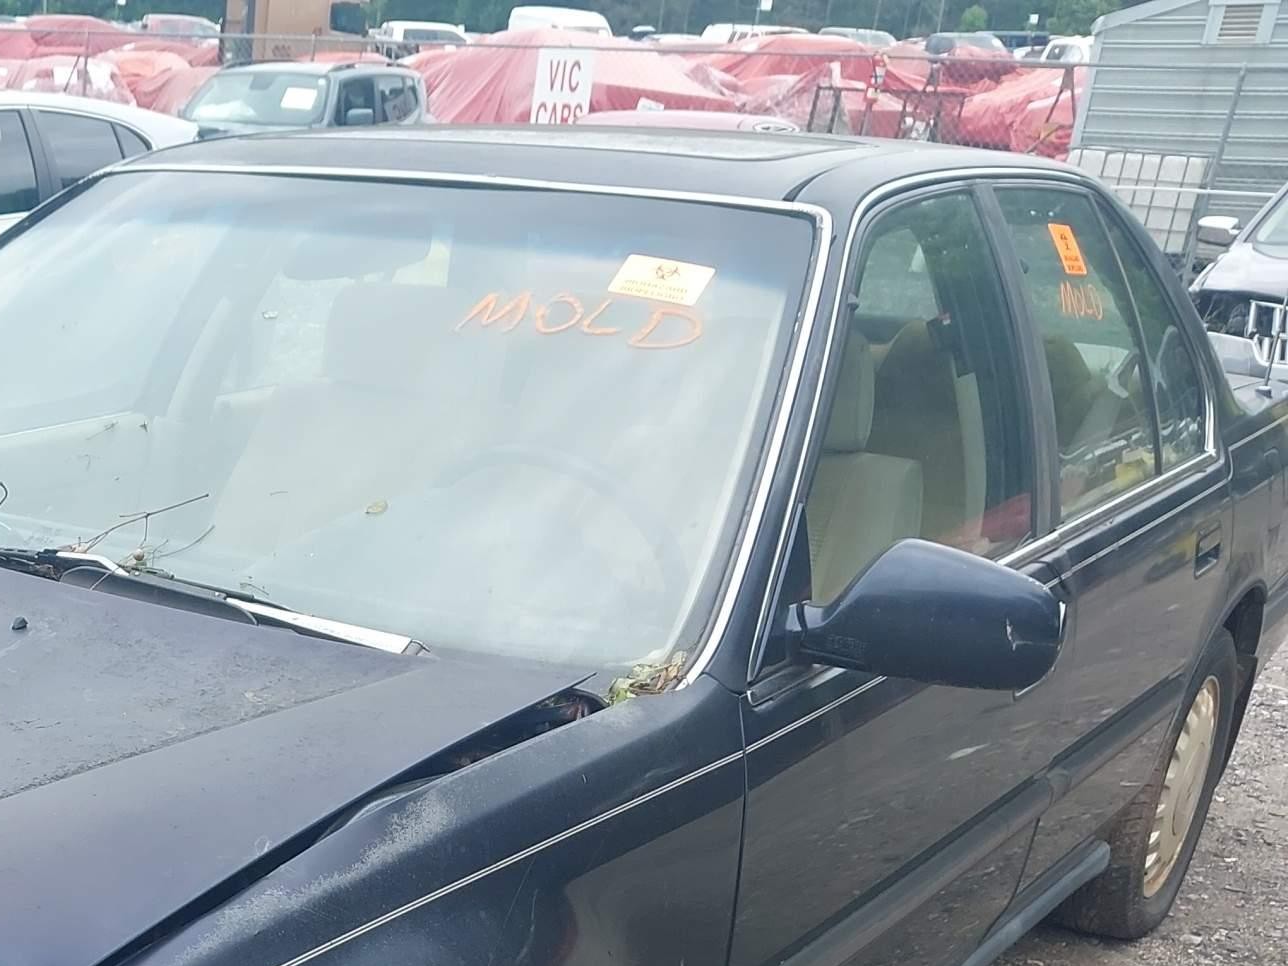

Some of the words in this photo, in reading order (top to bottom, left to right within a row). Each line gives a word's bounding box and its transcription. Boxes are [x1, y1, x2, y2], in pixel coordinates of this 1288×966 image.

[549, 59, 581, 93] VIC
[450, 291, 703, 349] MOLD
[1060, 280, 1104, 321] MOLD
